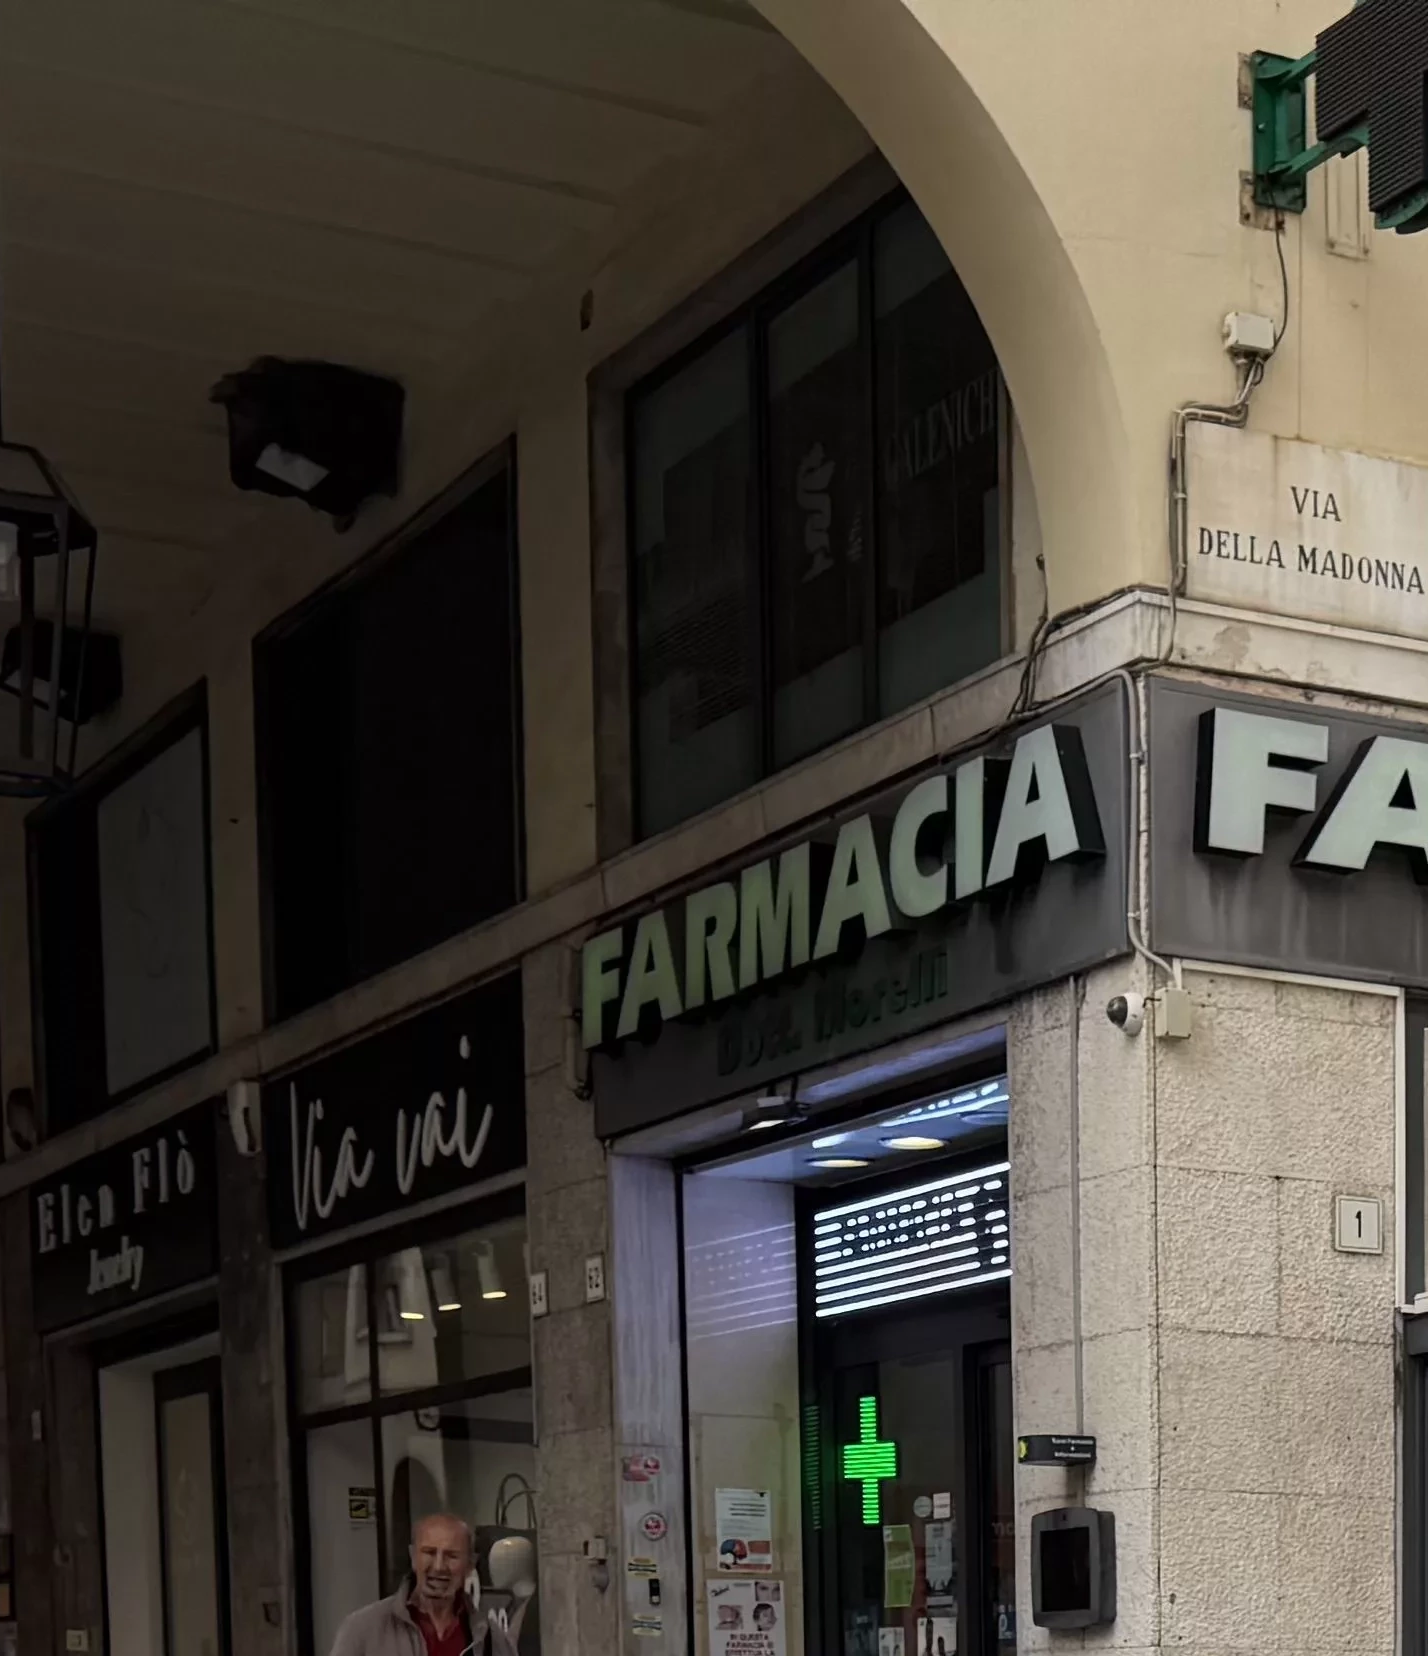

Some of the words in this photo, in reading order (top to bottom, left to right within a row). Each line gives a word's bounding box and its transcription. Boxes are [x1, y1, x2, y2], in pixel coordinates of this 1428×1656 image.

[1290, 485, 1342, 523] VIA
[1197, 527, 1285, 570] DELLA
[1297, 544, 1426, 596] MADONNA
[582, 724, 1097, 1051] FARMACIA
[289, 1080, 375, 1231] Via
[395, 1035, 494, 1195] vai
[37, 1183, 116, 1254] Elen
[132, 1129, 196, 1215] Flò
[1355, 1210, 1362, 1239] 1
